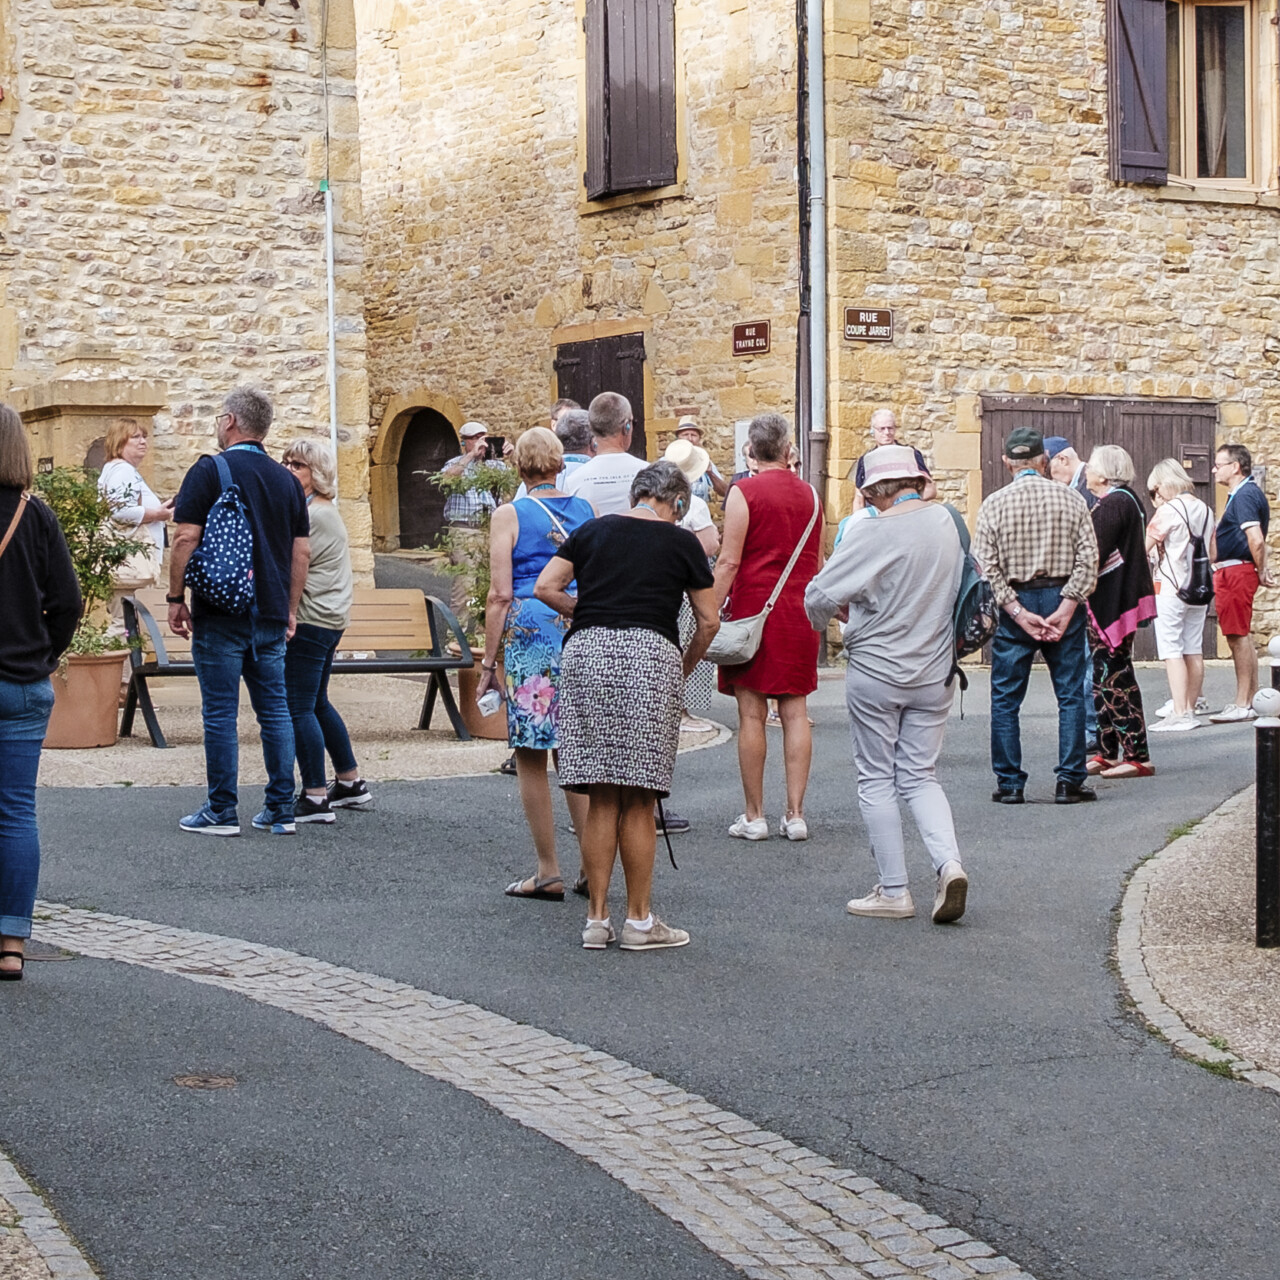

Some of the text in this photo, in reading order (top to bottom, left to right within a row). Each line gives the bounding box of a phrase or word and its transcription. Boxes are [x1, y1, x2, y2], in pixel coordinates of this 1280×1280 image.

[859, 312, 878, 323] RUE
[745, 327, 756, 336] RUE
[846, 325, 891, 337] COUPE JARRET
[755, 338, 766, 347] CUL
